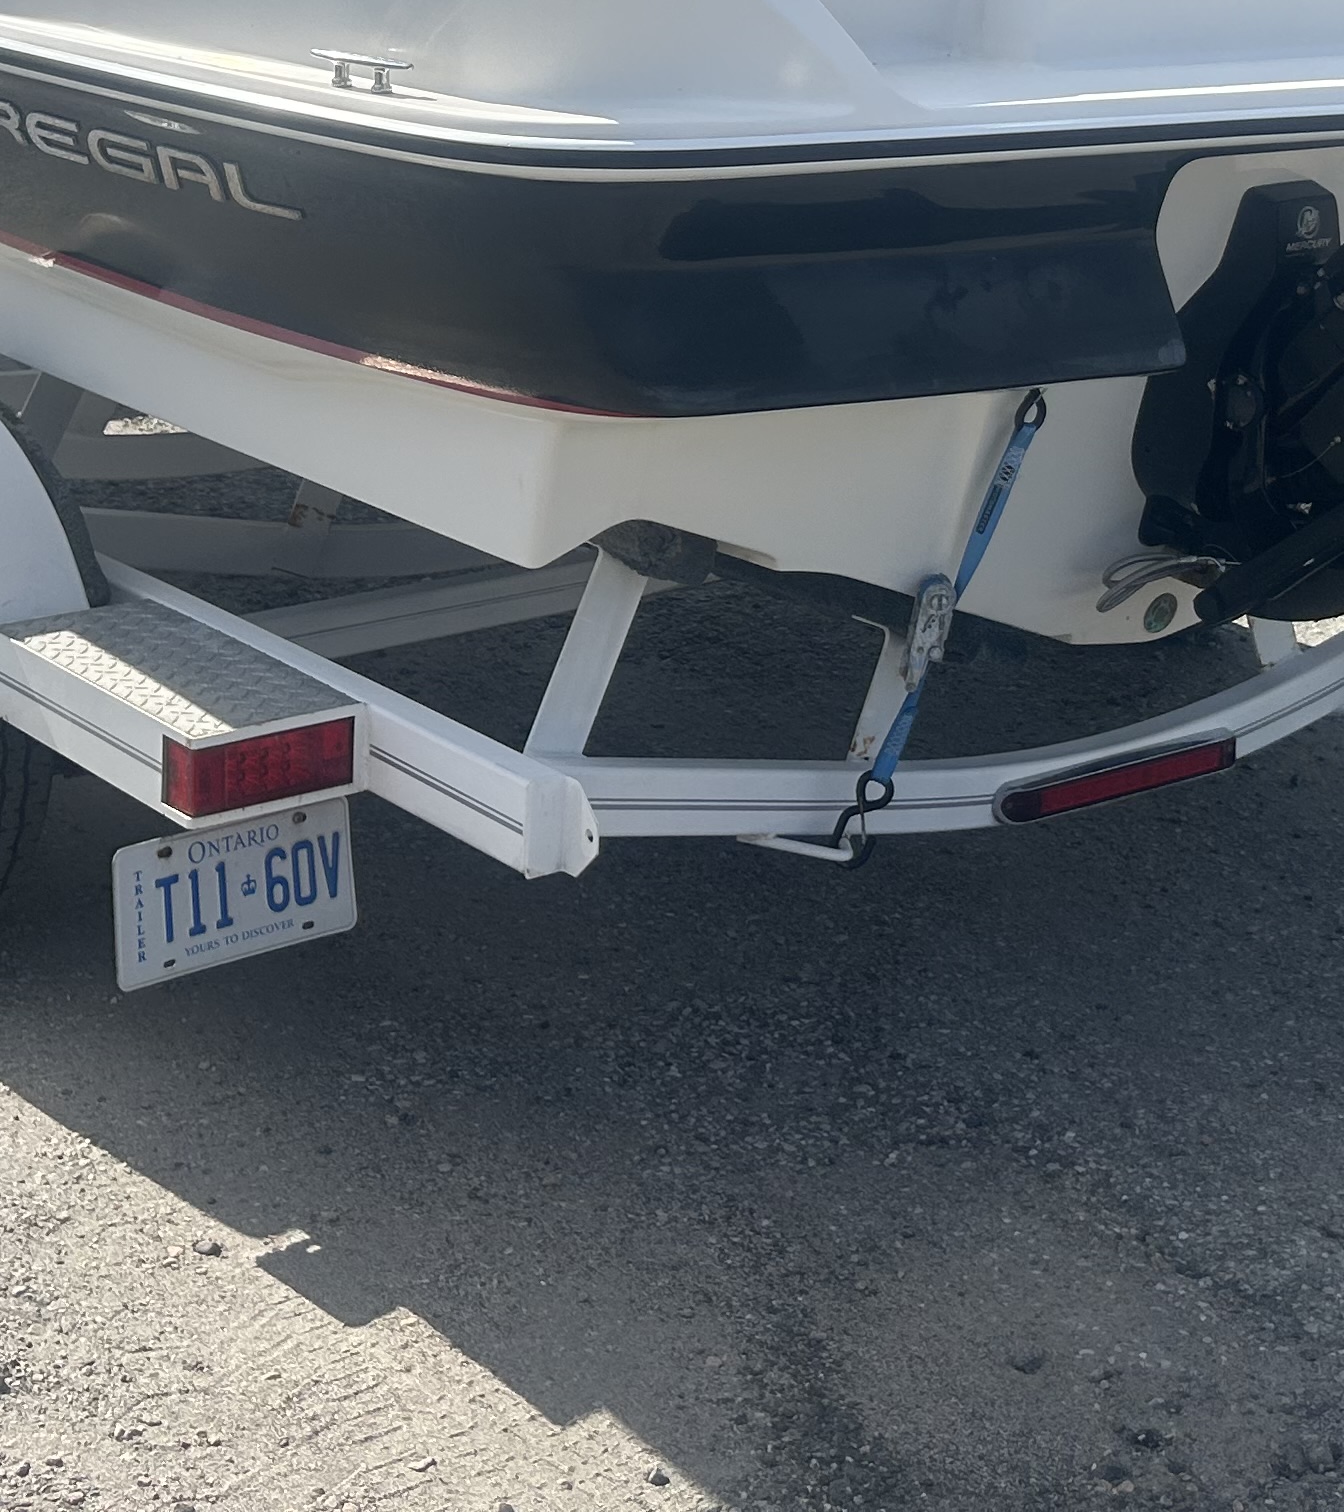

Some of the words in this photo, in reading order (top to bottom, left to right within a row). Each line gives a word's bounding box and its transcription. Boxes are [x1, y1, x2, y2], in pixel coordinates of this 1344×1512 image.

[1285, 237, 1332, 253] MERCURY
[188, 823, 280, 864] ONTARIO
[133, 870, 147, 963] TRAILER
[184, 940, 221, 957] YOURS
[224, 933, 239, 946] TO
[242, 919, 295, 941] DISCOVER
